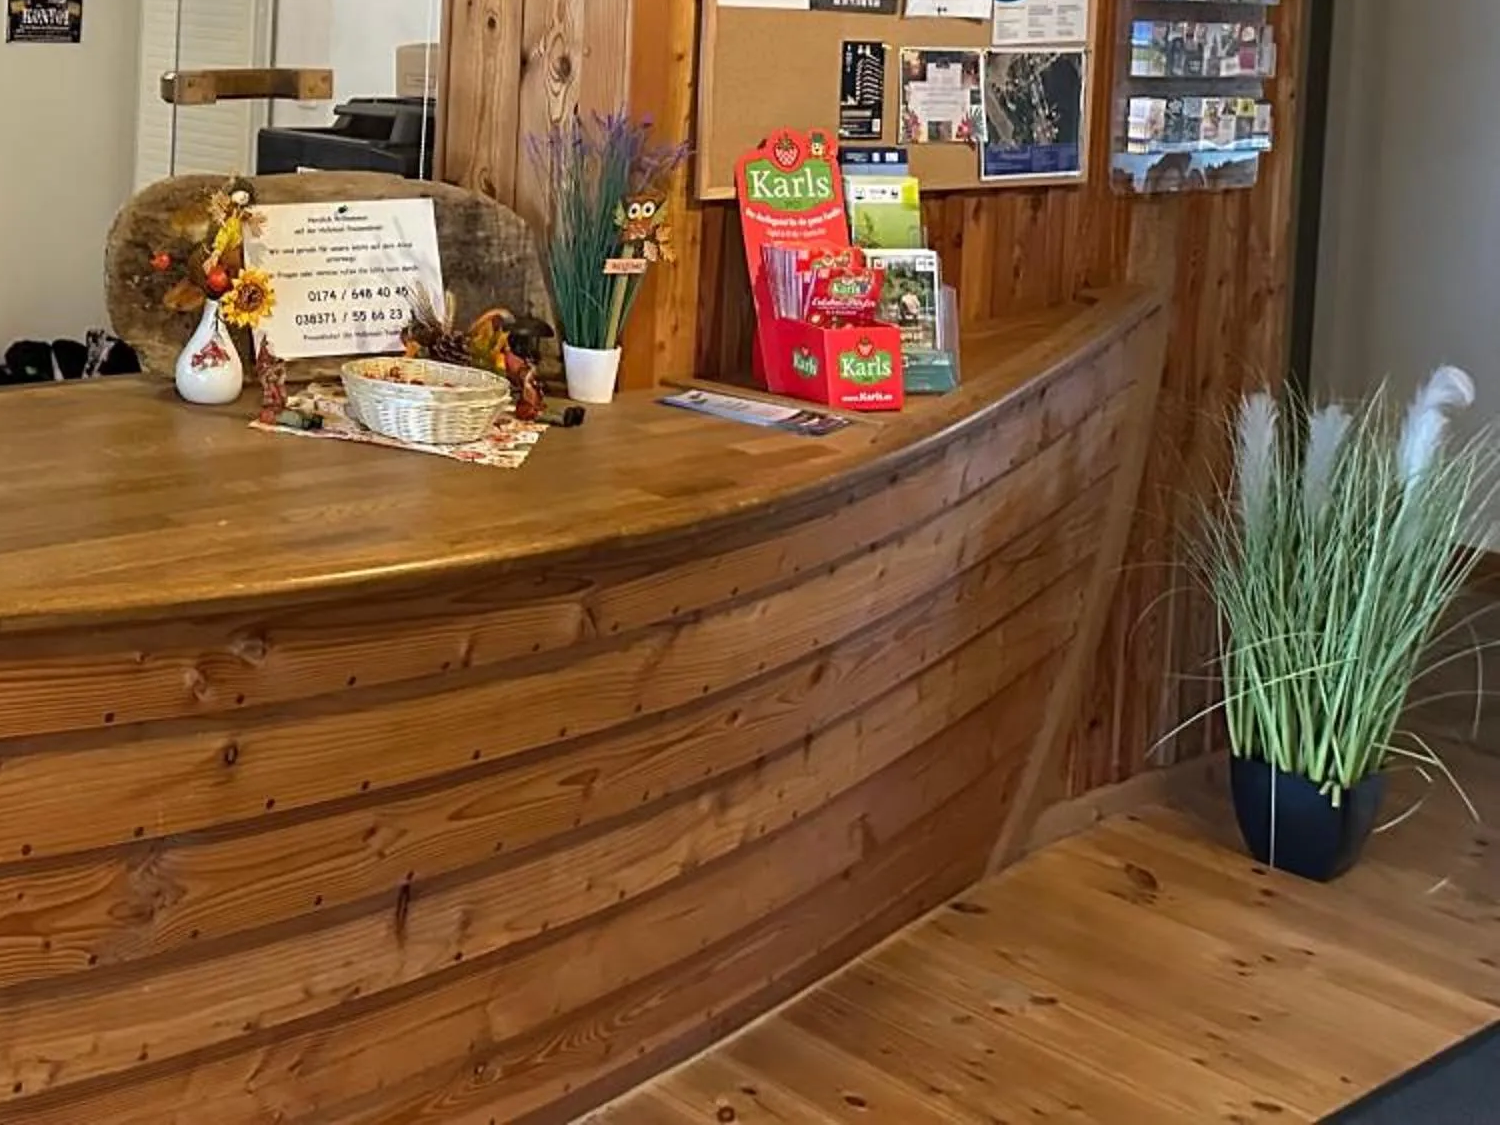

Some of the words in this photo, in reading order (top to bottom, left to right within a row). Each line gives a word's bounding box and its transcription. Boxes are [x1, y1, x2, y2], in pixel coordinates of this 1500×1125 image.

[750, 167, 830, 199] Karls
[308, 289, 337, 302] 0174
[351, 287, 373, 300] 648
[377, 286, 391, 298] 40
[295, 312, 337, 325] 038371
[389, 308, 403, 320] 23
[841, 357, 892, 377] Karls
